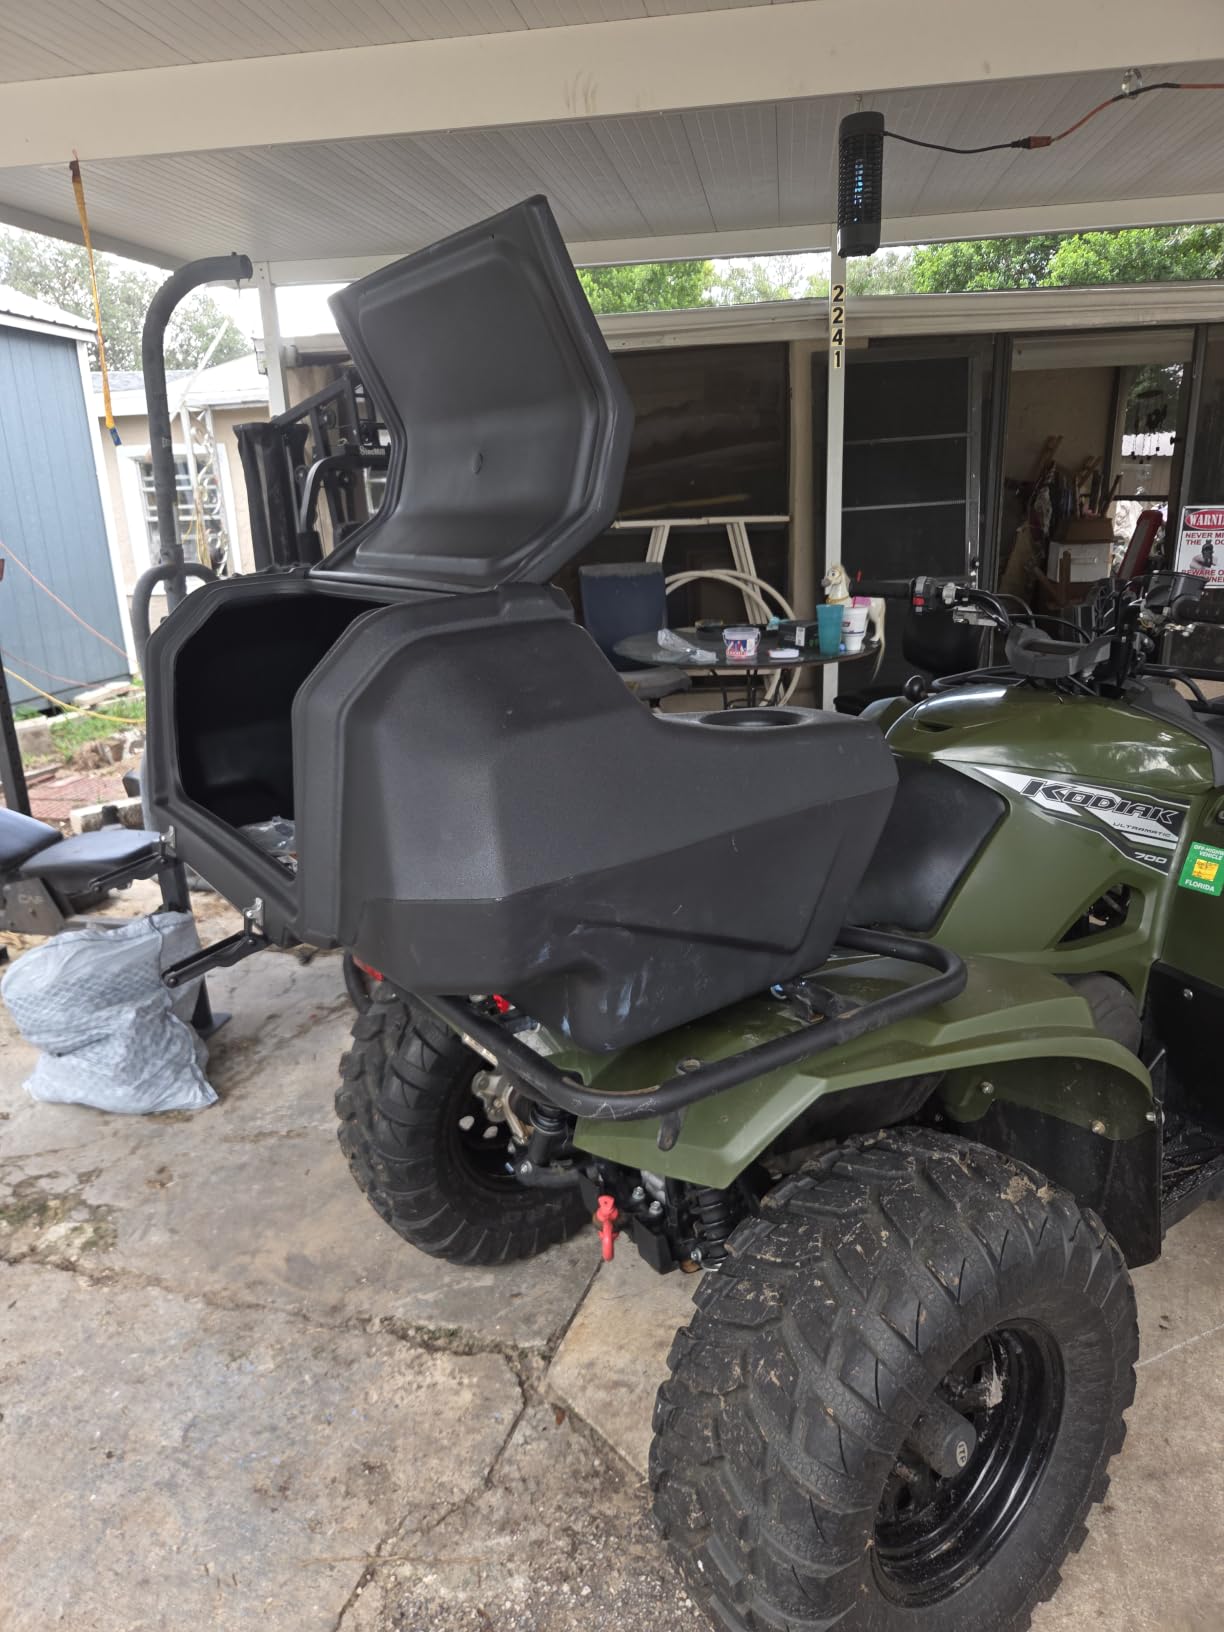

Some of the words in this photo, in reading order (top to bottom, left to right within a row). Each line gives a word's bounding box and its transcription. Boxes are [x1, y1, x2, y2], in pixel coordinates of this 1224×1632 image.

[832, 284, 845, 368] 2241
[1190, 514, 1224, 526] WARNI
[1020, 778, 1179, 825] KODIAK
[1112, 821, 1172, 838] ULTRAMATIC
[1133, 851, 1168, 864] 700
[1199, 850, 1223, 861] VEHICLE
[1184, 878, 1215, 893] FLORIDA
[957, 1442, 967, 1464] ITP
